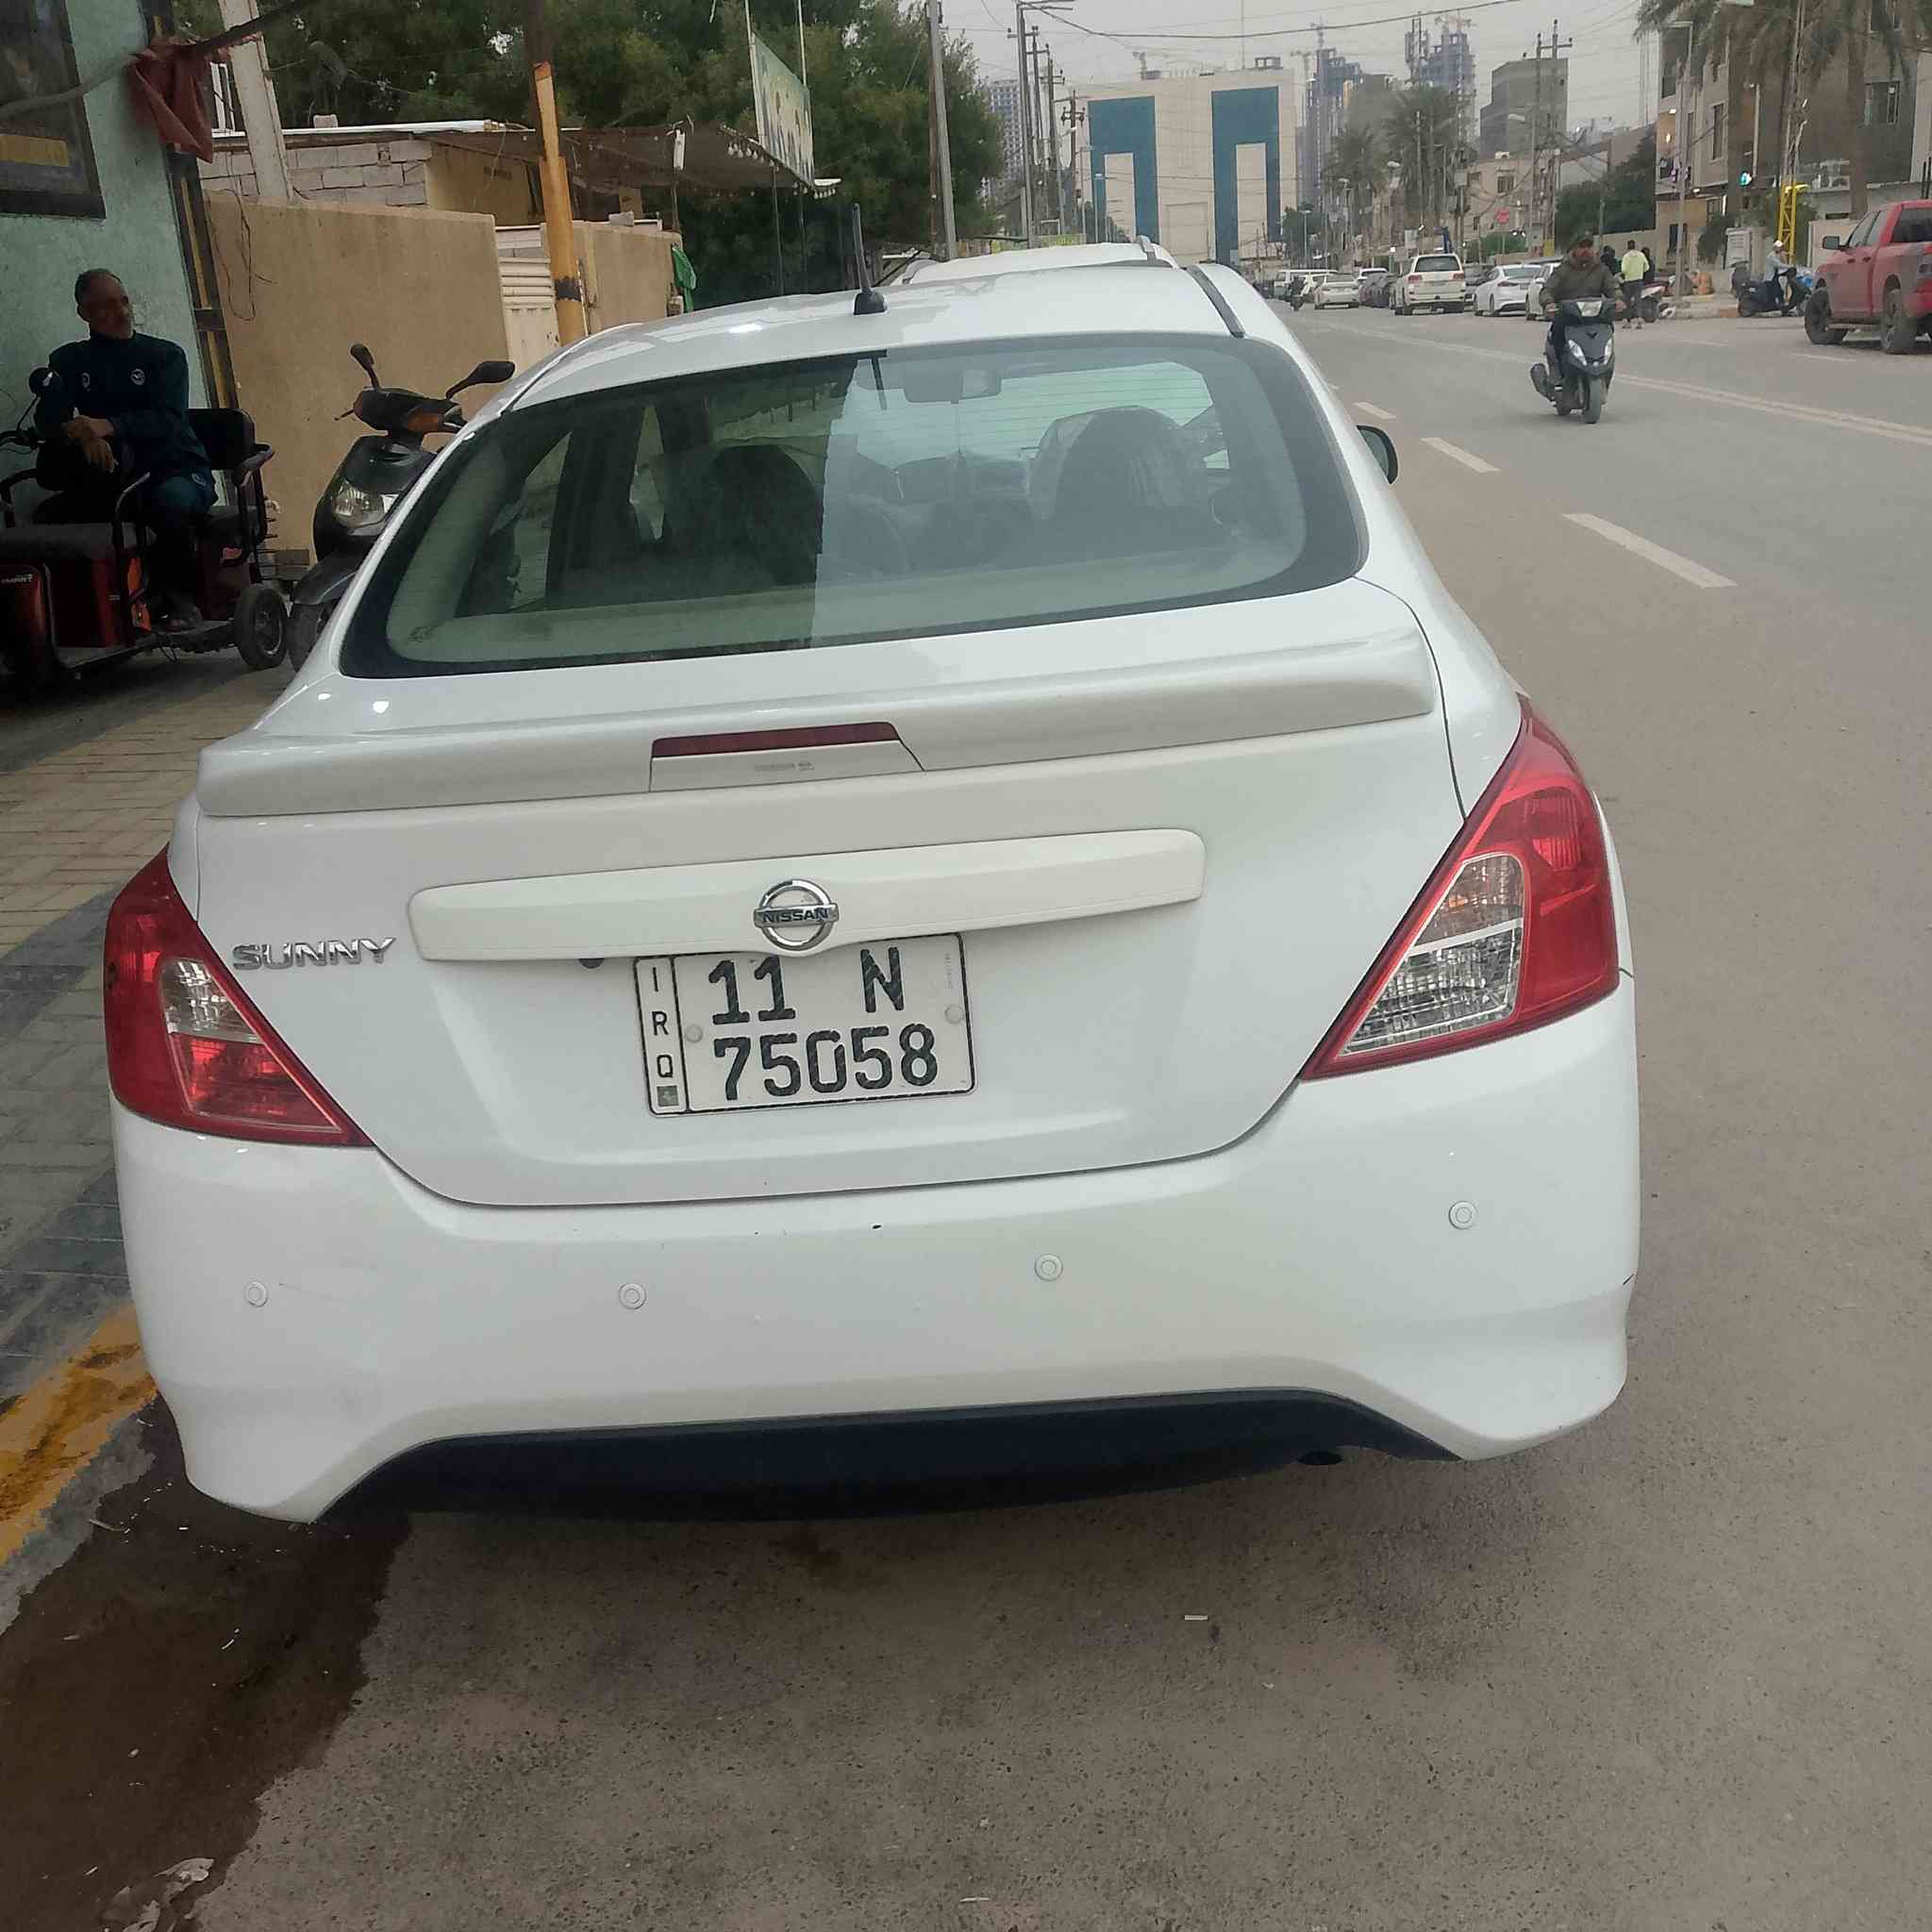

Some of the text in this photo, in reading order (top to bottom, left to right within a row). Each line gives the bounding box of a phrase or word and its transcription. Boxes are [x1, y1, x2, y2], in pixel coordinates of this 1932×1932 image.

[762, 908, 828, 924] NISSAN
[232, 937, 396, 971] SUNNY
[708, 954, 796, 1025] 11
[859, 946, 905, 1013] N
[713, 1022, 939, 1101] 75058
